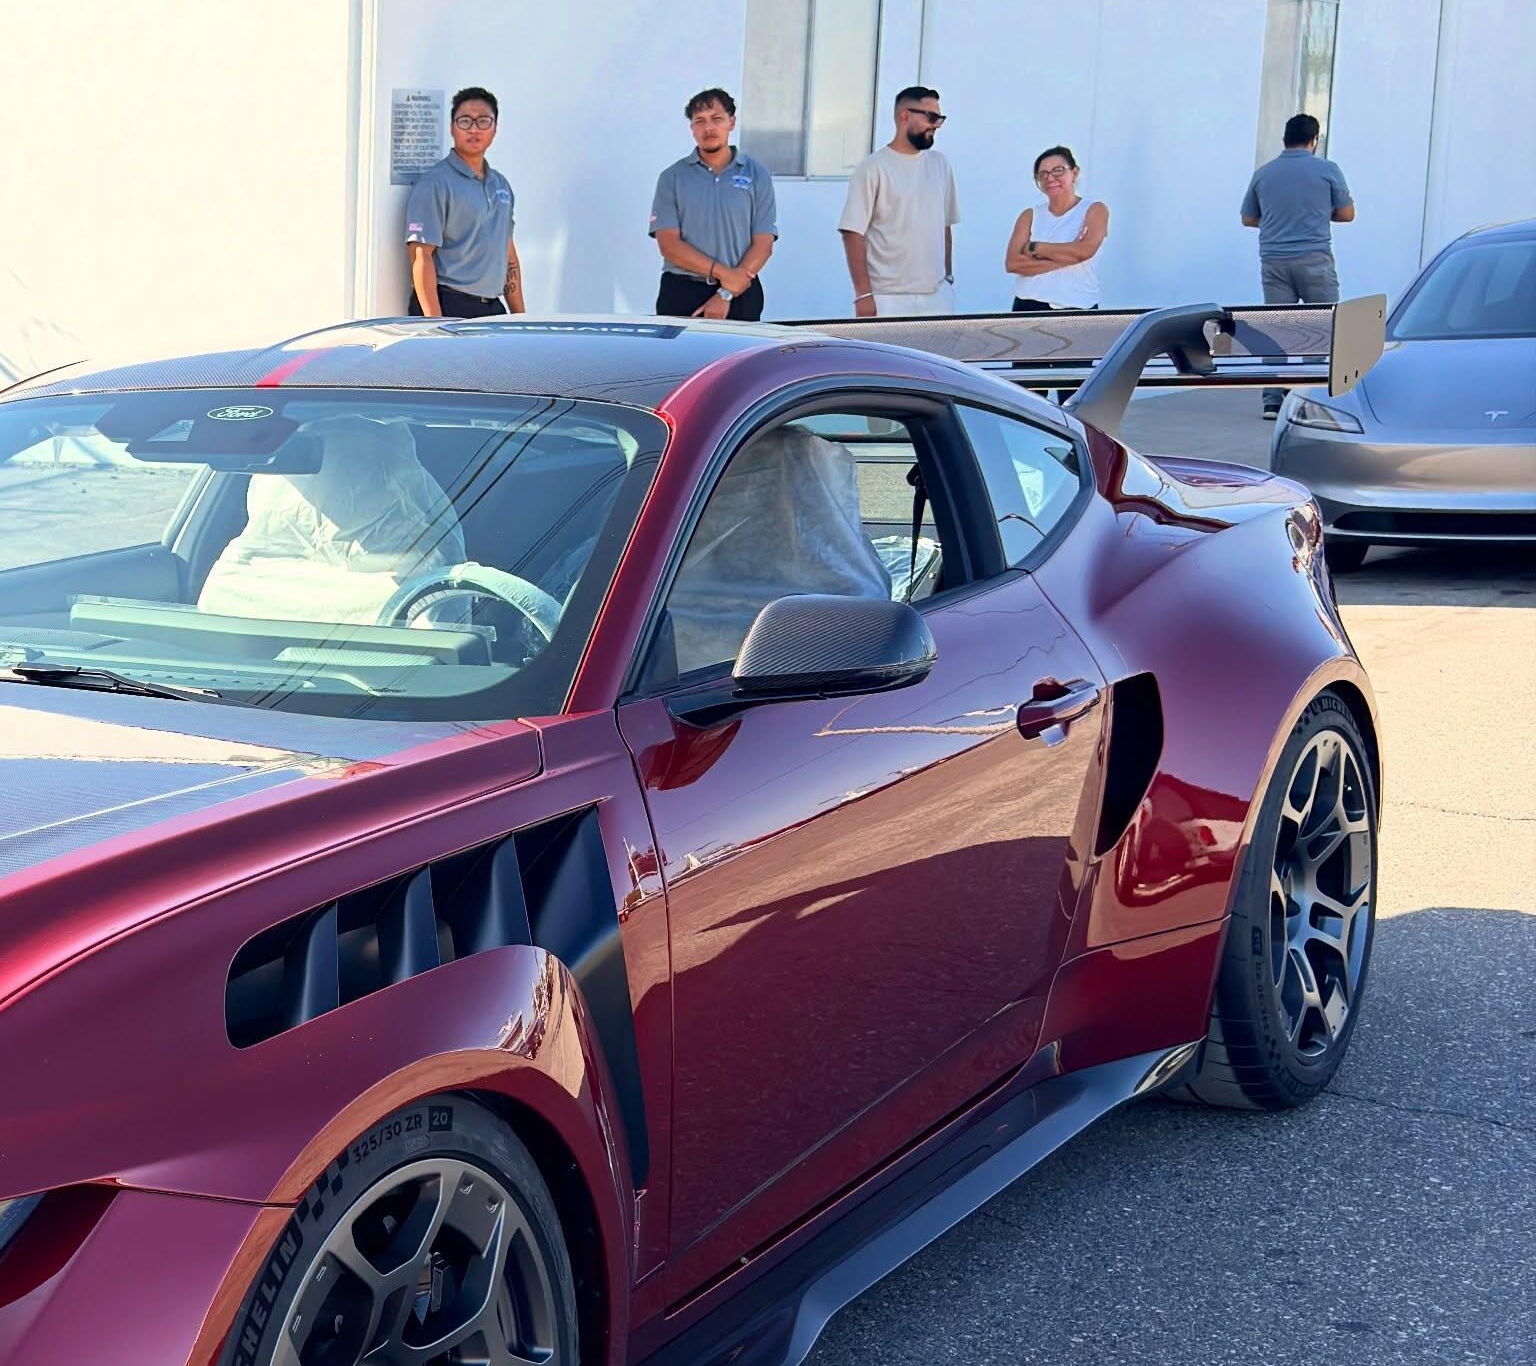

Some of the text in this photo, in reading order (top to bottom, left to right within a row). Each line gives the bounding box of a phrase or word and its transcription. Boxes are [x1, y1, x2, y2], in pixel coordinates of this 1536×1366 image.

[217, 406, 264, 418] Ford
[352, 1121, 402, 1164] 325/30
[405, 1115, 423, 1133] ZR
[432, 1111, 448, 1126] 20
